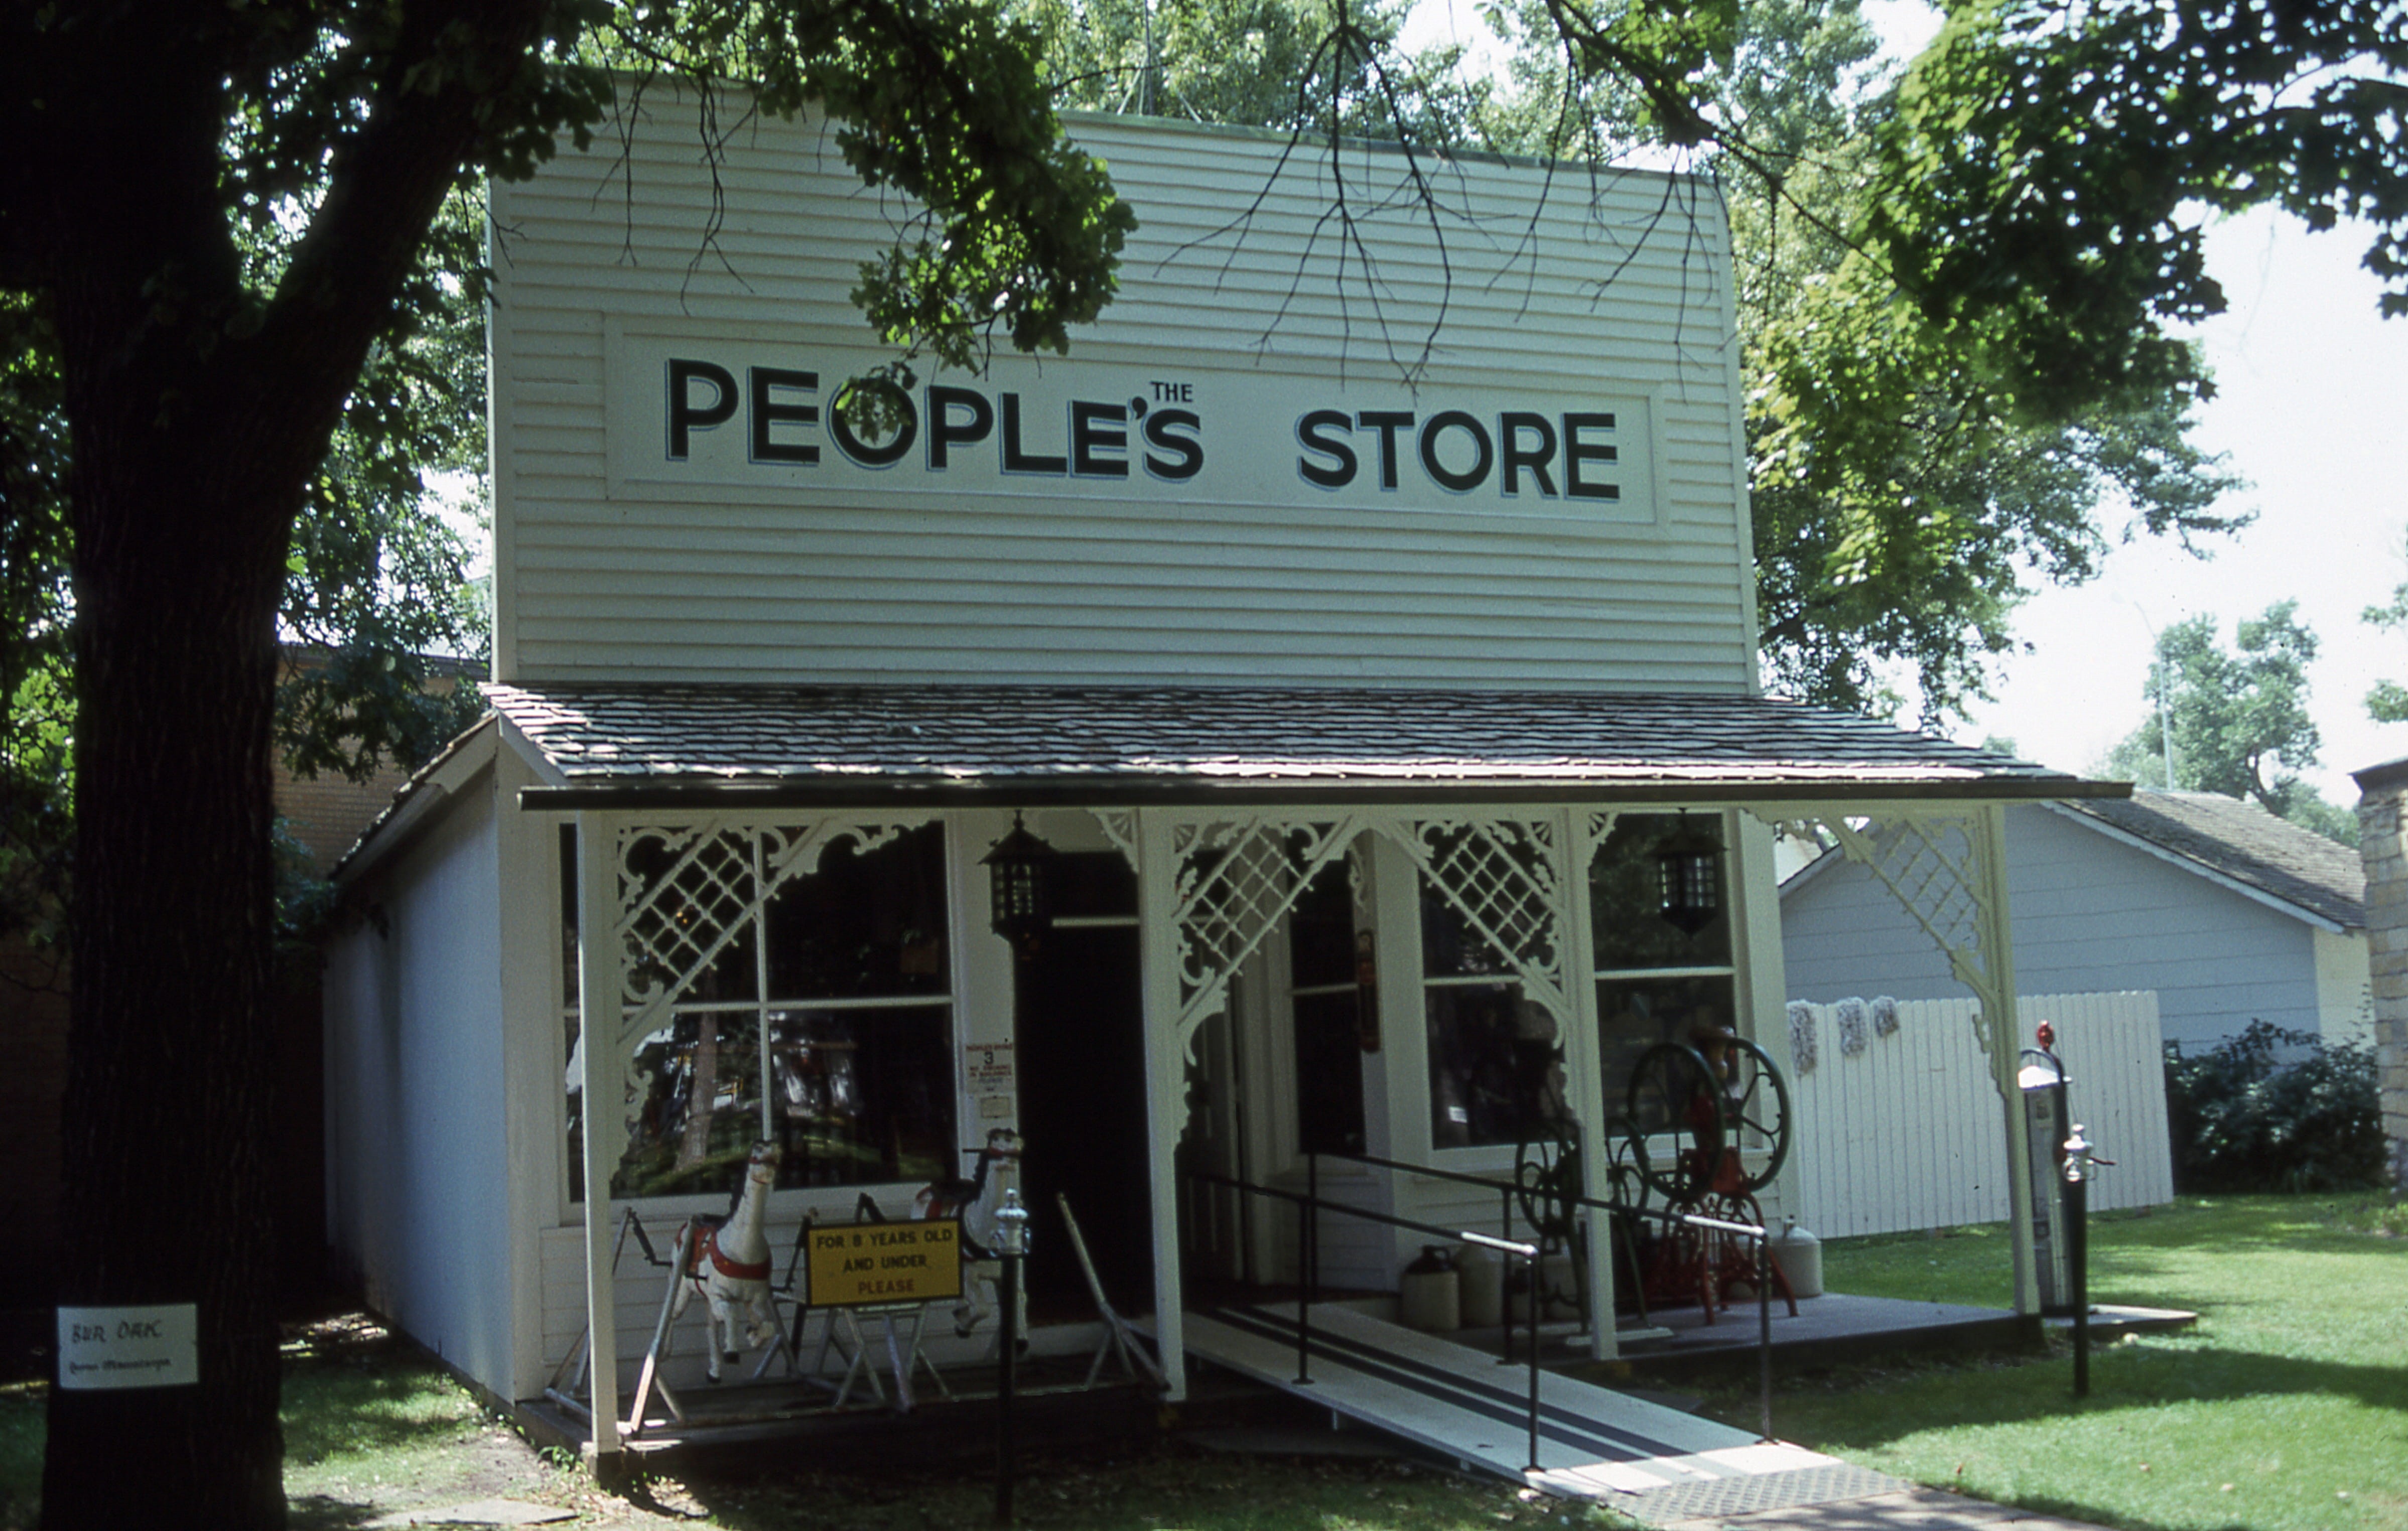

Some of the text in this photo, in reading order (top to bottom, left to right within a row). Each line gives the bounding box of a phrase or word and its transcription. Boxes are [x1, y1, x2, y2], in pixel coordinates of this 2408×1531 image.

[1150, 380, 1193, 403] THE
[664, 358, 1205, 482] PEOPLE'S
[1295, 409, 1621, 503] STORE
[984, 1052, 993, 1064] 3
[817, 1235, 845, 1248] FOR
[870, 1232, 917, 1245] YEARS
[924, 1229, 952, 1242] OLD
[843, 1255, 927, 1272] AND UNDER
[858, 1279, 914, 1294] PLEASE
